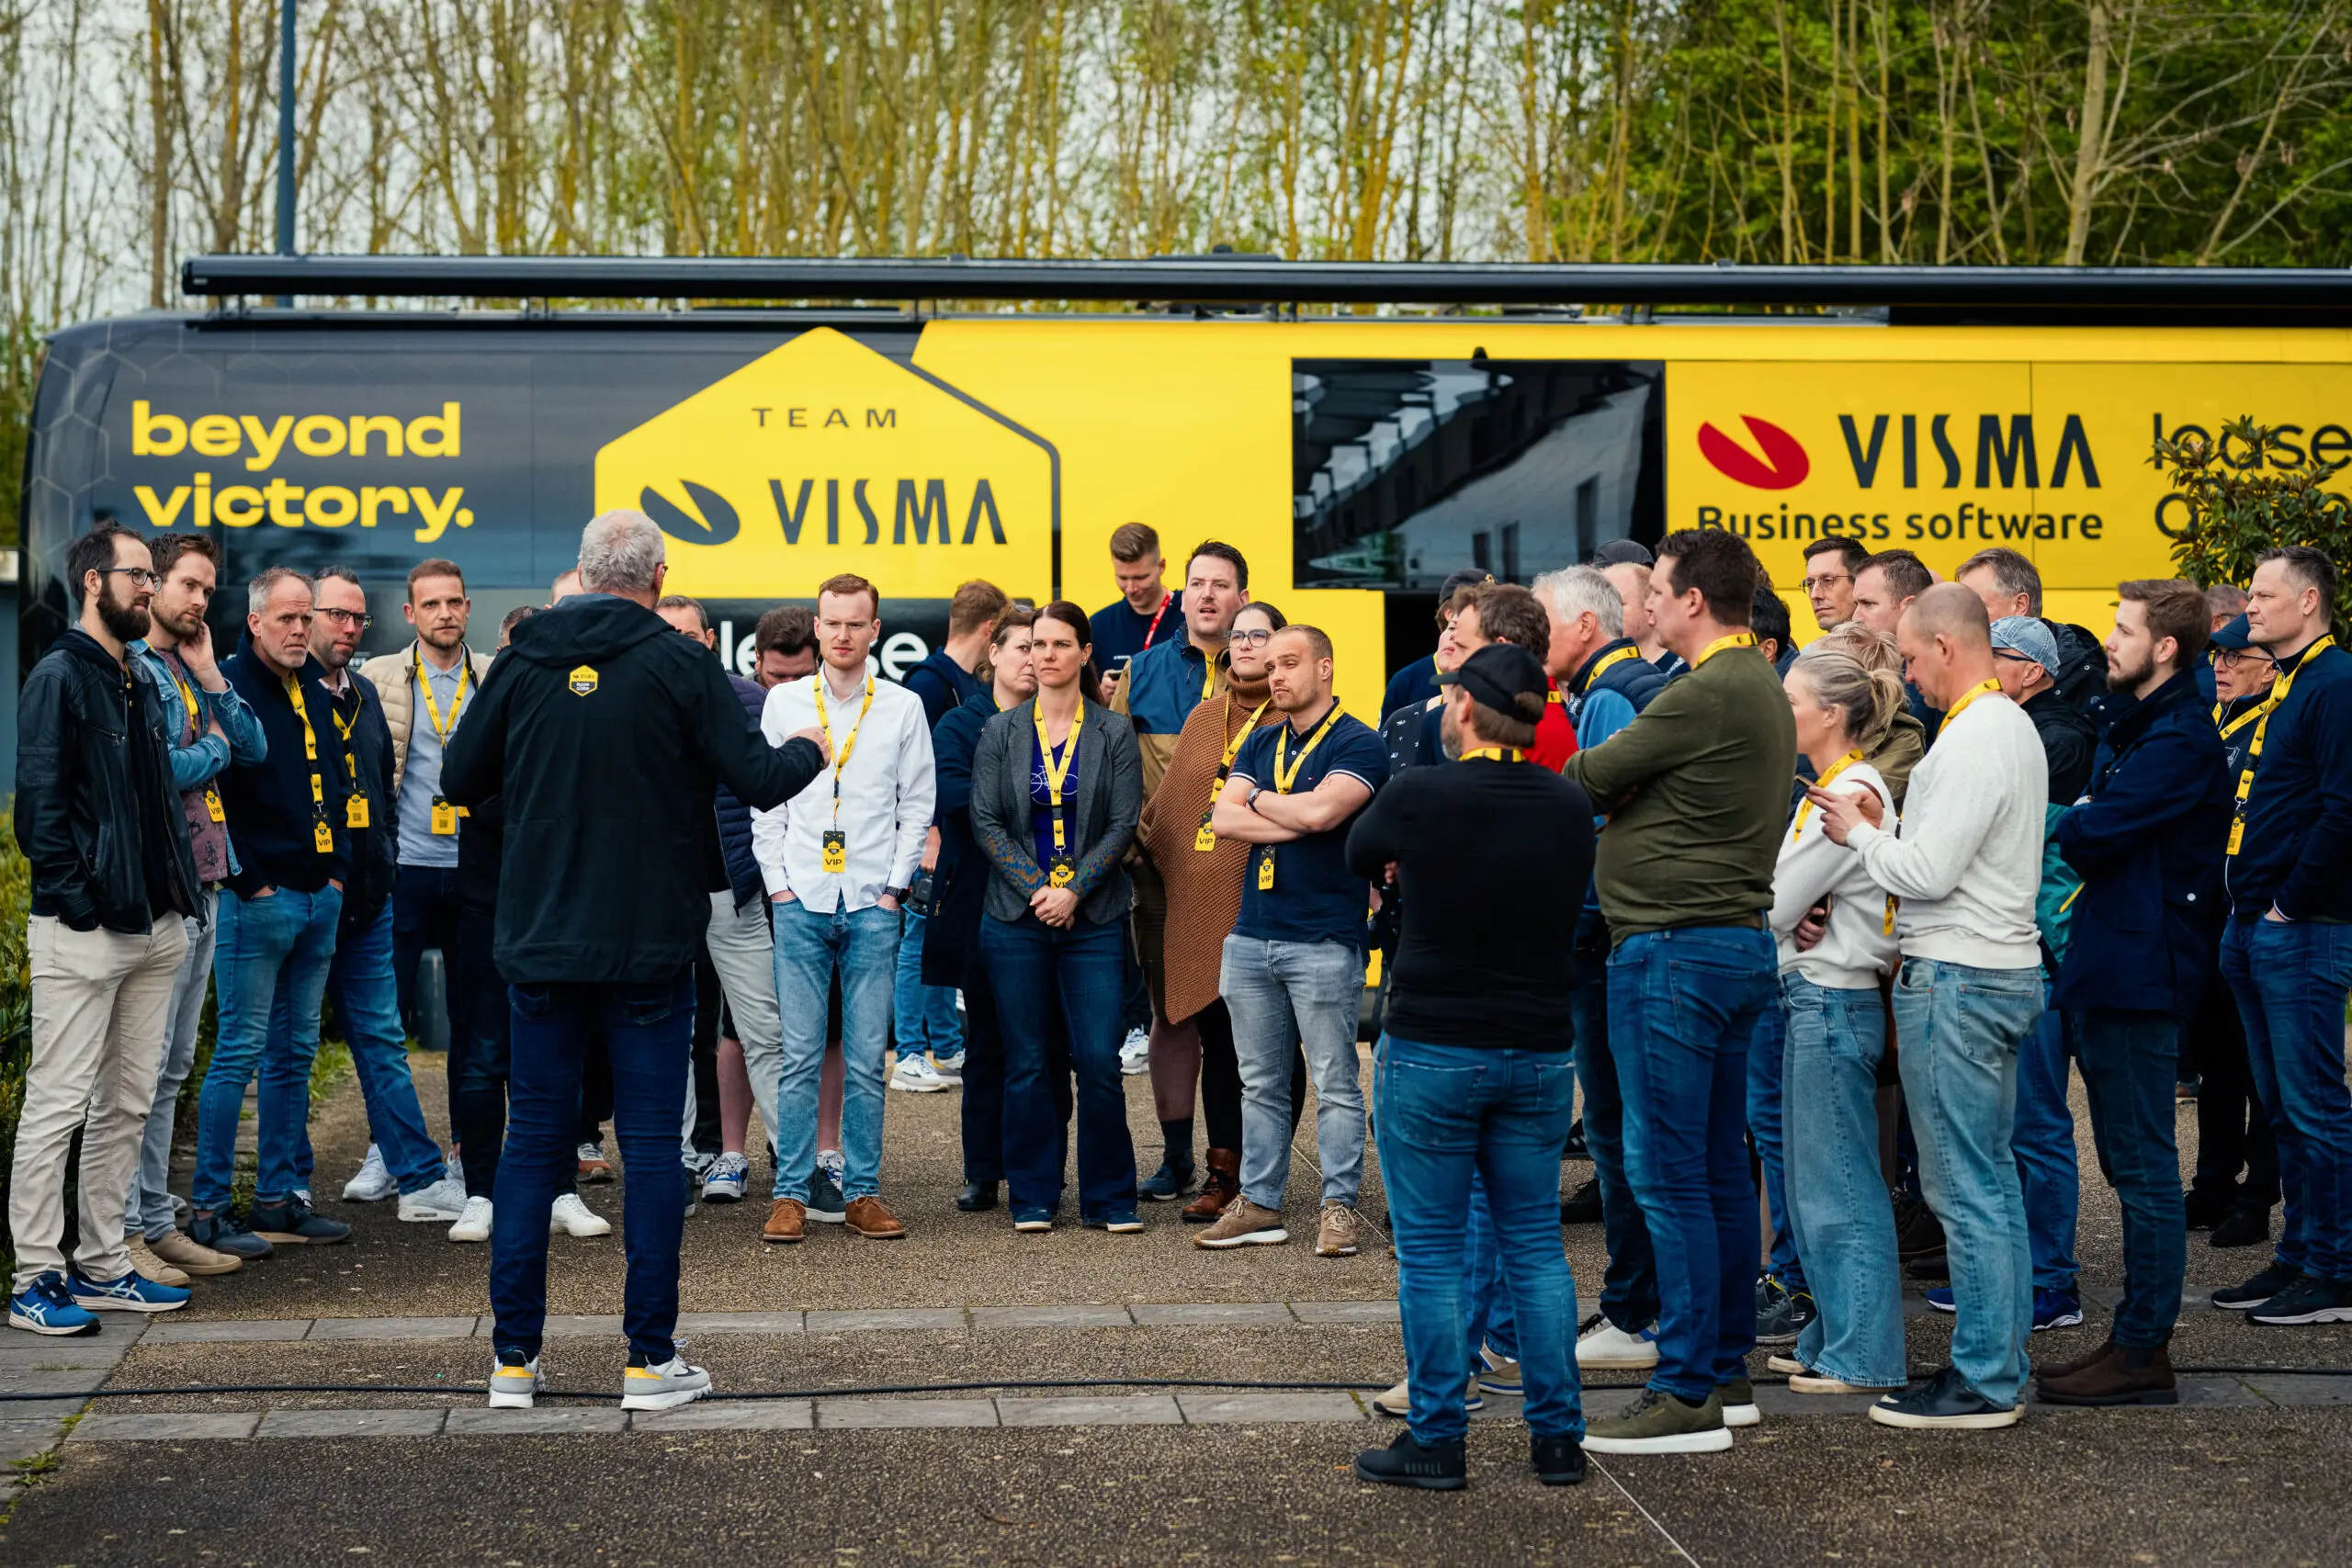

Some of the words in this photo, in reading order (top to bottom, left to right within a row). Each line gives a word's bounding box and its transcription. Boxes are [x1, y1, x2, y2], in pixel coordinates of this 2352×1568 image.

[752, 408, 897, 428] TEAM
[132, 400, 461, 471] beyond
[1838, 413, 2102, 489] VISMA
[132, 472, 474, 543] victory.
[768, 479, 1008, 545] VISMA
[1698, 503, 1891, 540] Business
[1905, 503, 2103, 540] software
[210, 807, 221, 815] VIP
[317, 839, 331, 847] VIP
[1198, 837, 1214, 845] VIP
[824, 858, 842, 866] VIP
[1260, 874, 1272, 884] VIP
